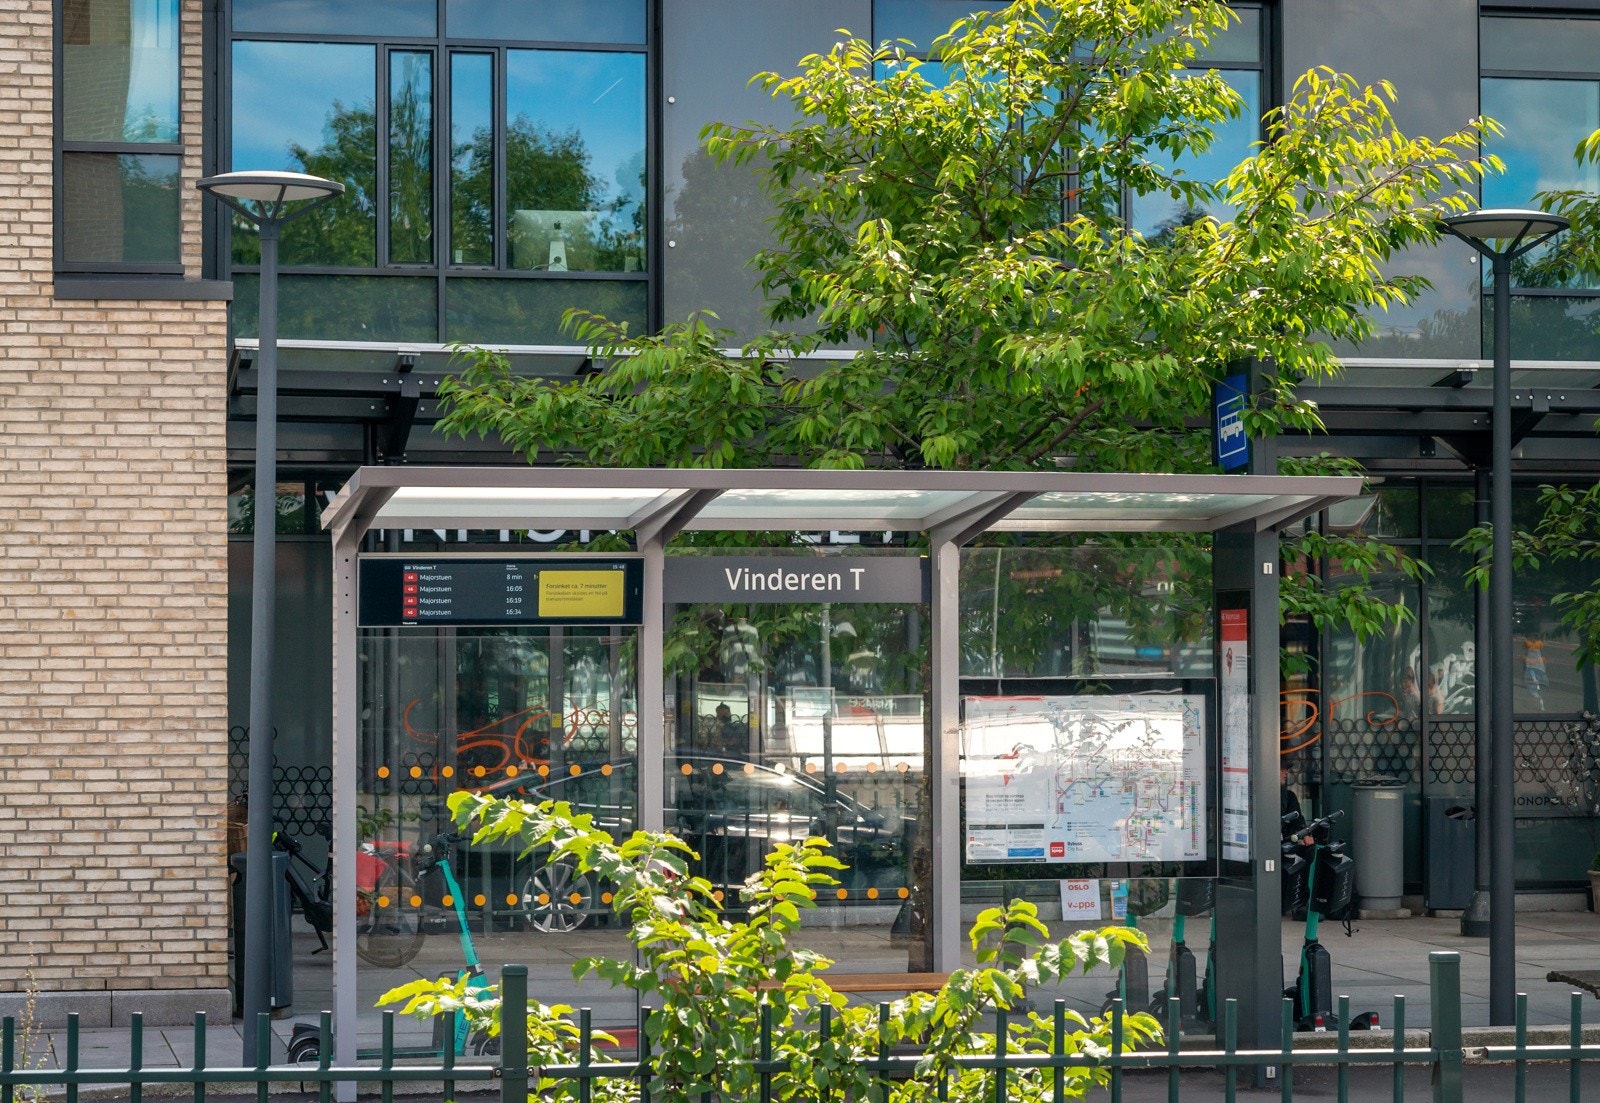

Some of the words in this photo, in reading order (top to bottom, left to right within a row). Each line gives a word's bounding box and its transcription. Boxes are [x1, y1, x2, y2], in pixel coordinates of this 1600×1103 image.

[725, 567, 842, 591] Vinderen
[850, 567, 865, 591] T
[419, 597, 452, 605] Majorstuen
